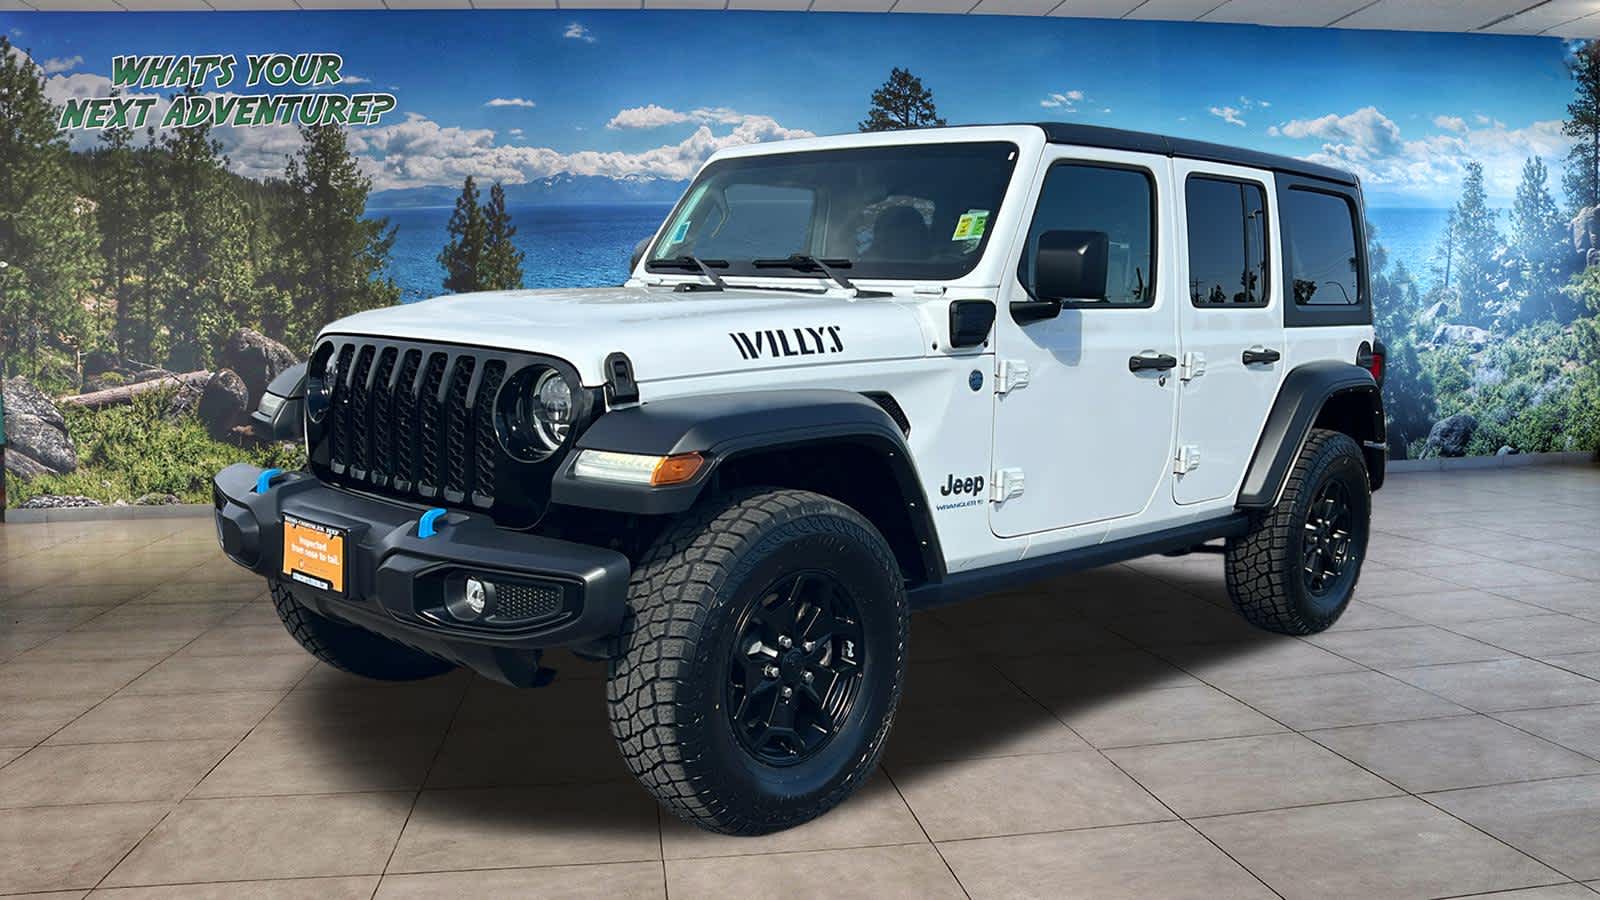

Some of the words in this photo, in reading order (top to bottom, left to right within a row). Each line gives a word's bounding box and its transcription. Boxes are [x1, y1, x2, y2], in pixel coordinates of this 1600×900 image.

[112, 54, 237, 88] WHAT'S
[246, 53, 343, 87] YOUR
[58, 96, 159, 130] NEXT
[160, 93, 396, 128] ADVENTURE?
[728, 325, 844, 360] WILLYS
[940, 473, 985, 497] Jeep
